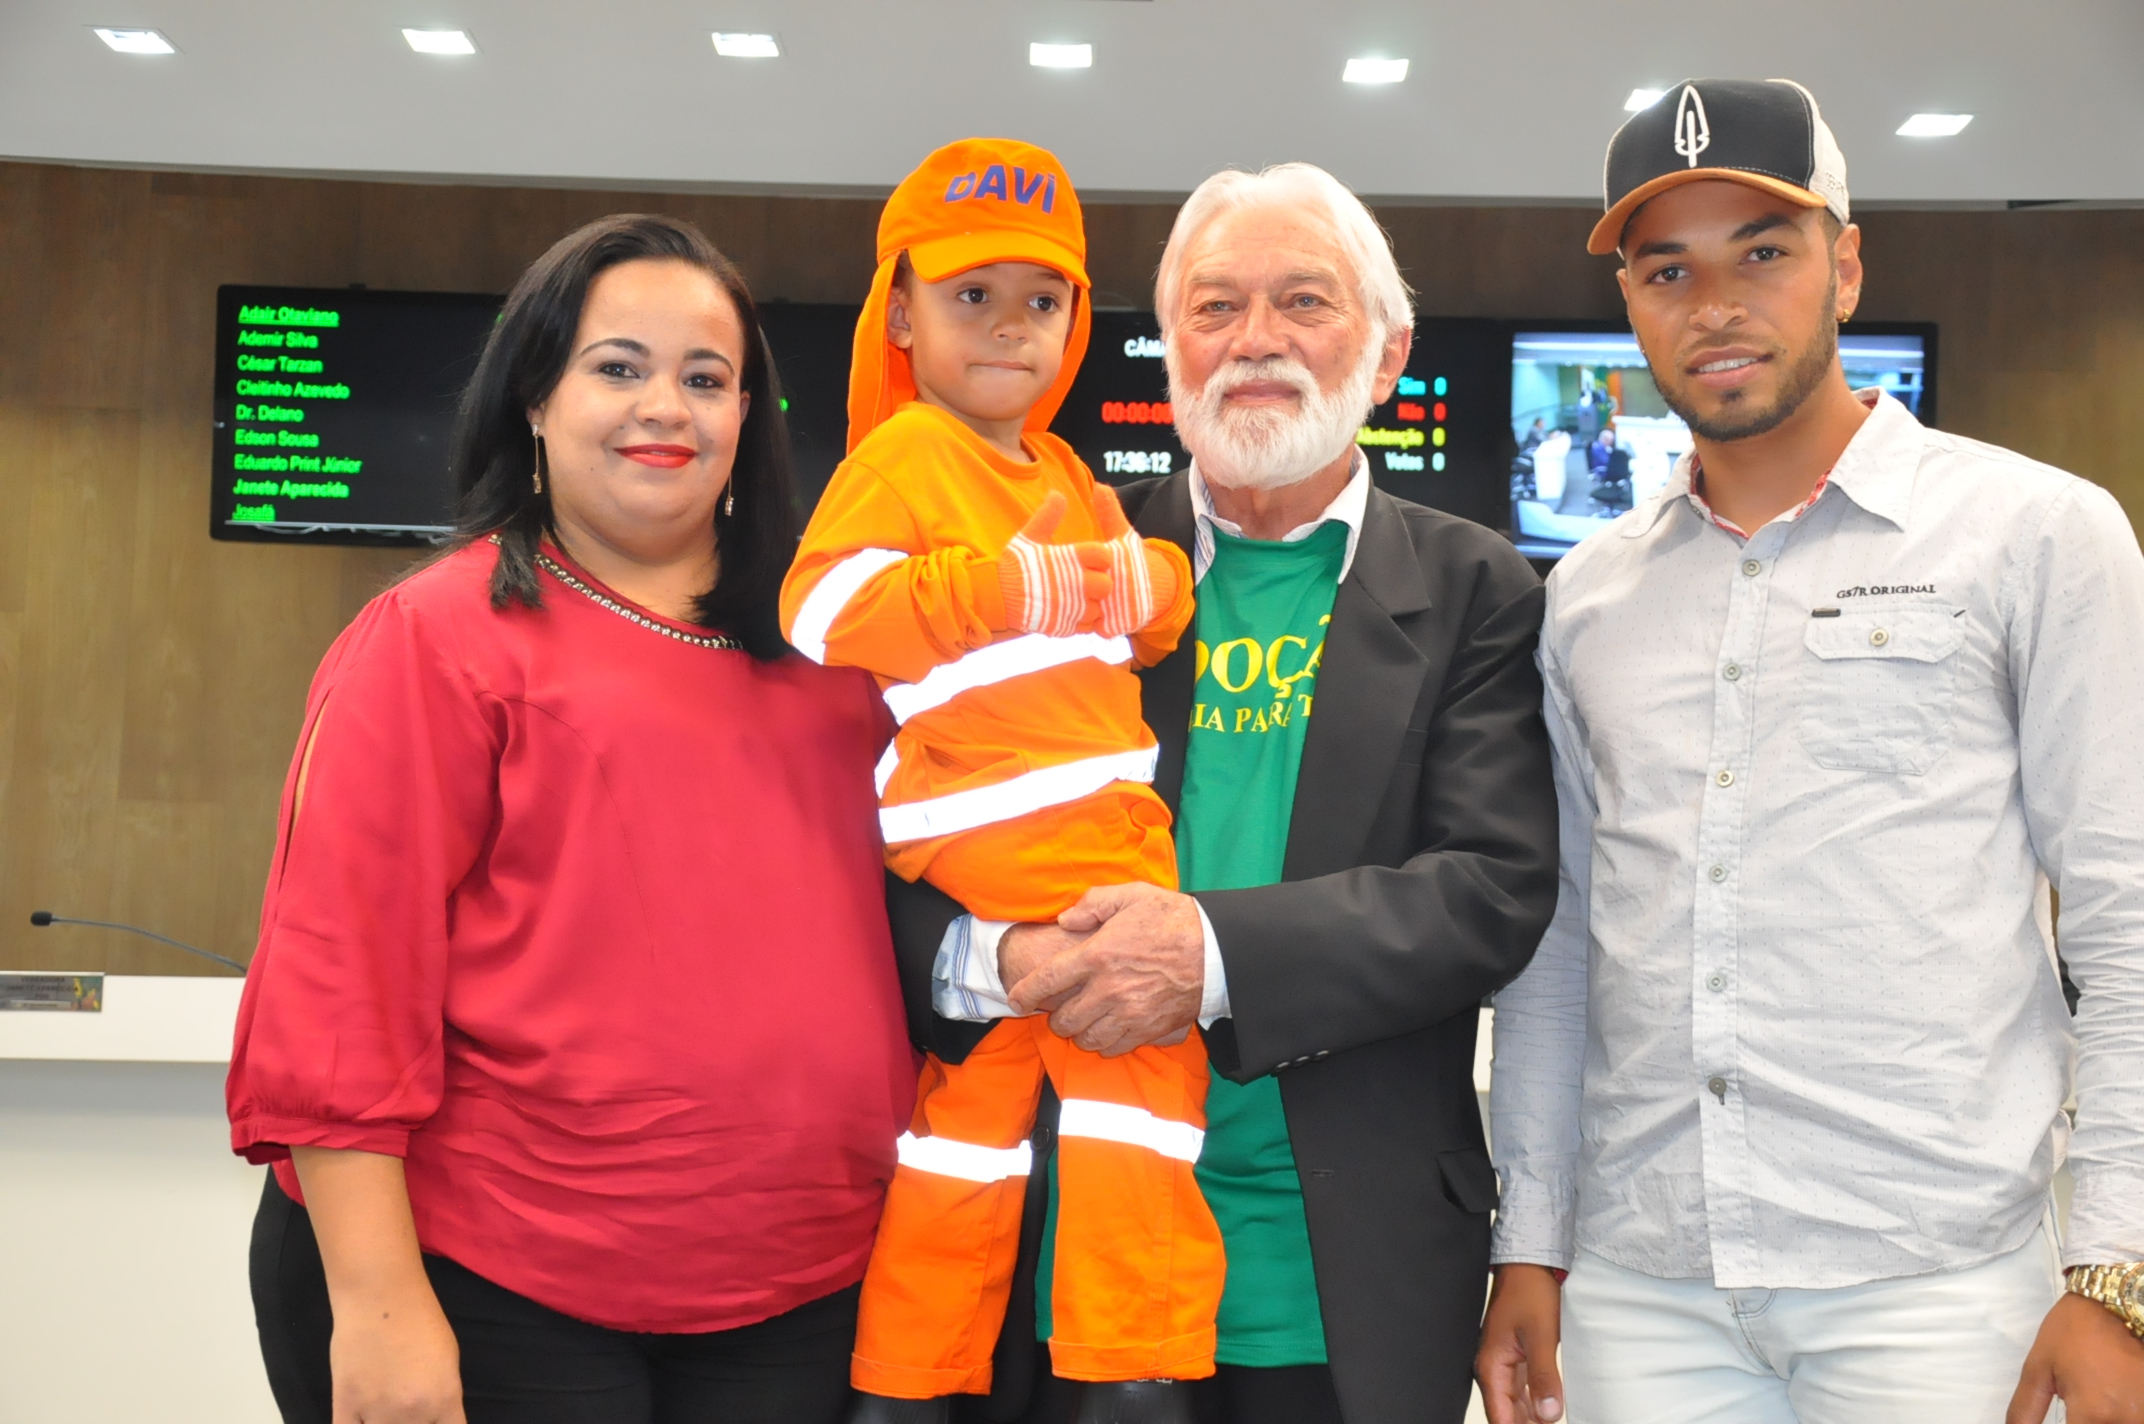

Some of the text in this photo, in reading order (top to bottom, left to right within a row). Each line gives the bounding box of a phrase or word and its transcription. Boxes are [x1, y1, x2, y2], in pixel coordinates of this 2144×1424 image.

[238, 305, 339, 324] Adair Otaviano
[238, 330, 319, 348] Ademir Silva
[237, 355, 323, 373] César Tarzan
[293, 382, 350, 399] Azevedo
[1434, 376, 1447, 396] 0
[235, 404, 304, 422] Dr. Delano
[1433, 402, 1447, 422] 0
[235, 429, 319, 447] Edson Sousa
[1432, 427, 1446, 447] 0
[234, 454, 362, 474] Eduardo Print Júnior
[1432, 452, 1445, 471] 0
[233, 478, 350, 499] Janete Aparecida
[1870, 585, 1937, 595] ORIGINAL
